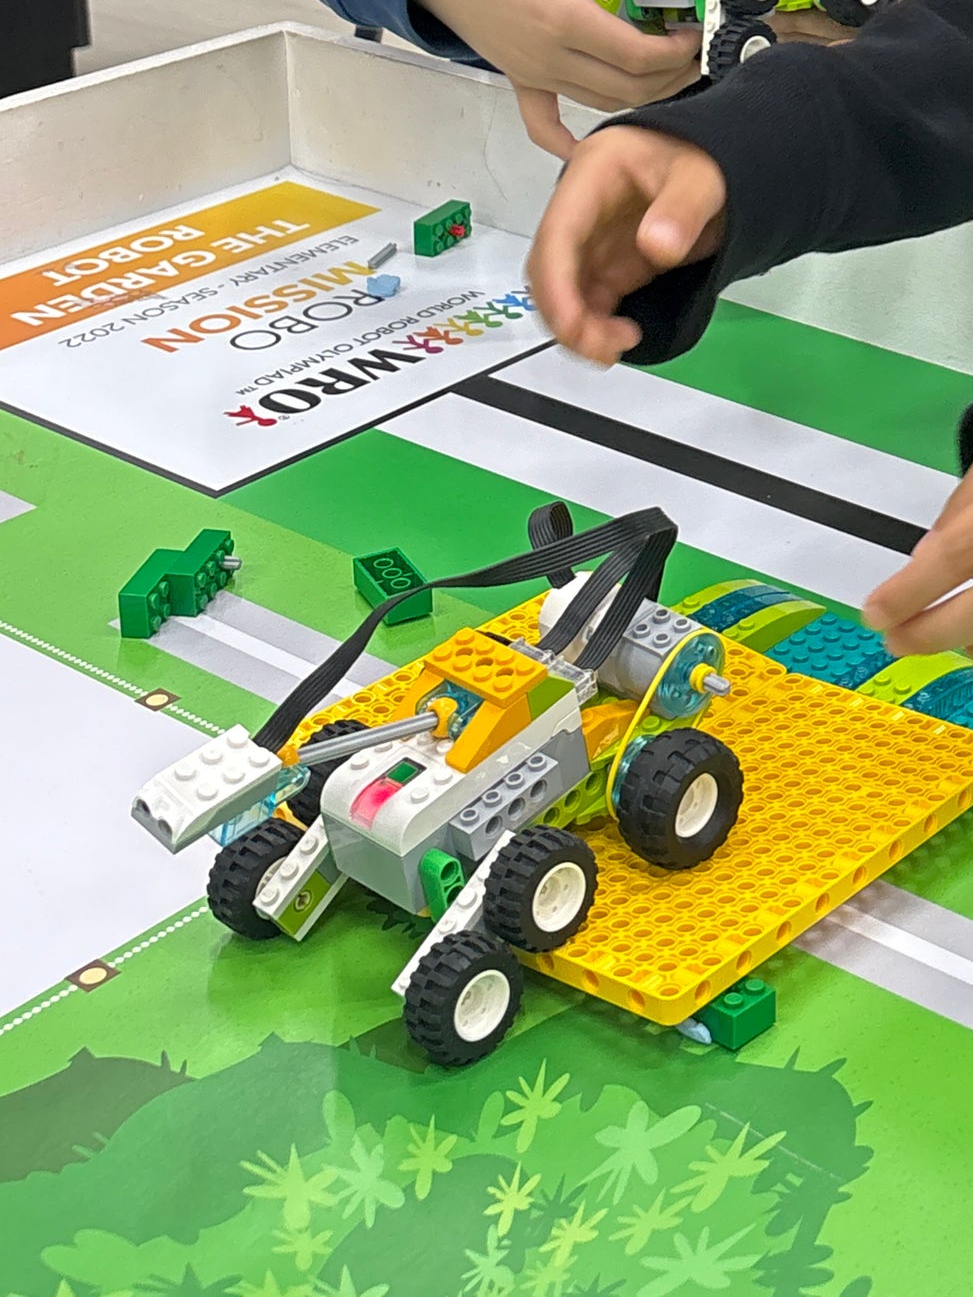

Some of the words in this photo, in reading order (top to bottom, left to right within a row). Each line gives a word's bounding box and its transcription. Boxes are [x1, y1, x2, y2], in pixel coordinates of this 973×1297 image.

[42, 224, 205, 286] ROBOT
[210, 219, 311, 253] THE
[229, 235, 359, 286] ELEMENTARY
[10, 250, 216, 326] GARDEN
[121, 286, 218, 325] SEASON
[141, 261, 376, 353] MISSION
[417, 290, 486, 319] WORLD
[58, 322, 125, 348] 2022
[229, 289, 386, 350] ROBO
[352, 316, 420, 345] ROBOT
